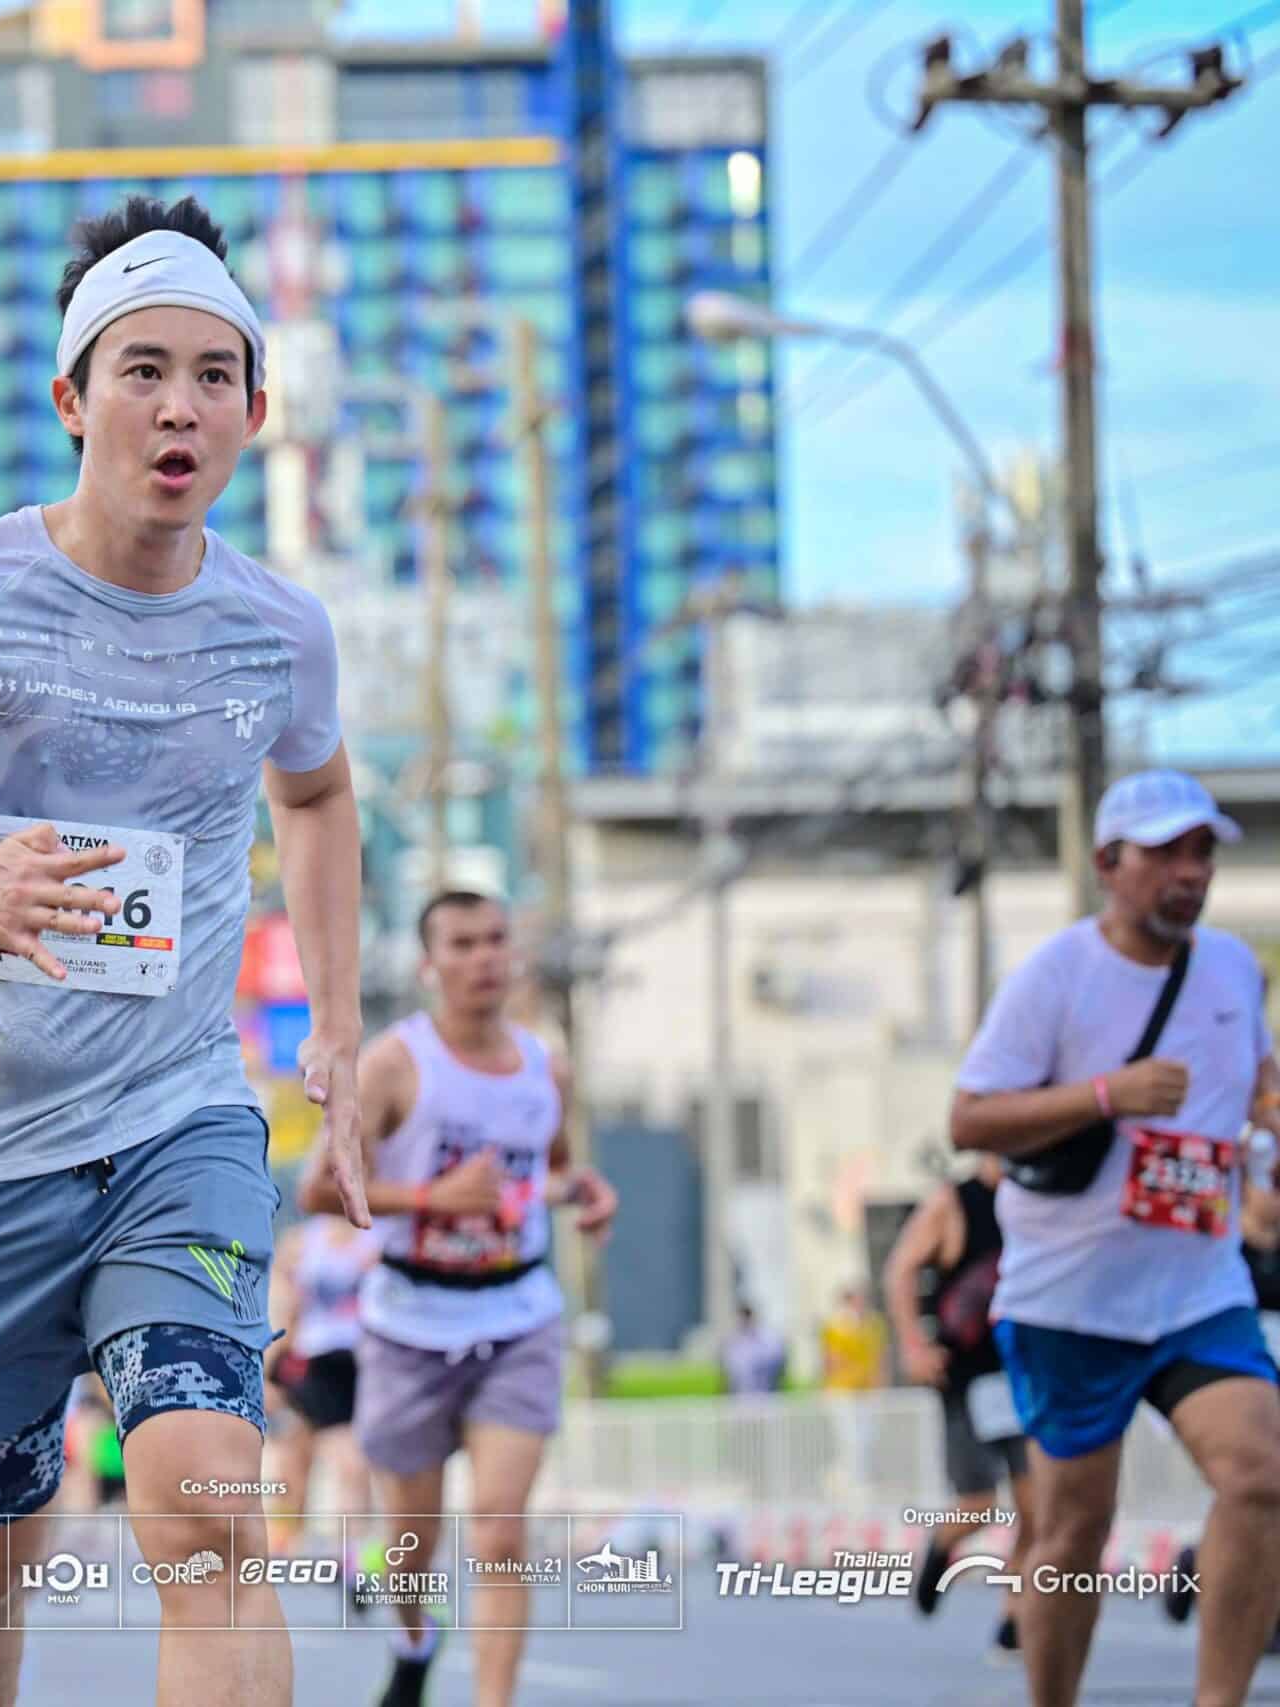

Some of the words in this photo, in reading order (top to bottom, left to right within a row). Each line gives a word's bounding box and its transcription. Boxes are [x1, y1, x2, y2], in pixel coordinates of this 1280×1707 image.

[25, 680, 97, 704] UNDER
[103, 696, 197, 714] ARMOUR
[57, 833, 110, 849] ATTAYA
